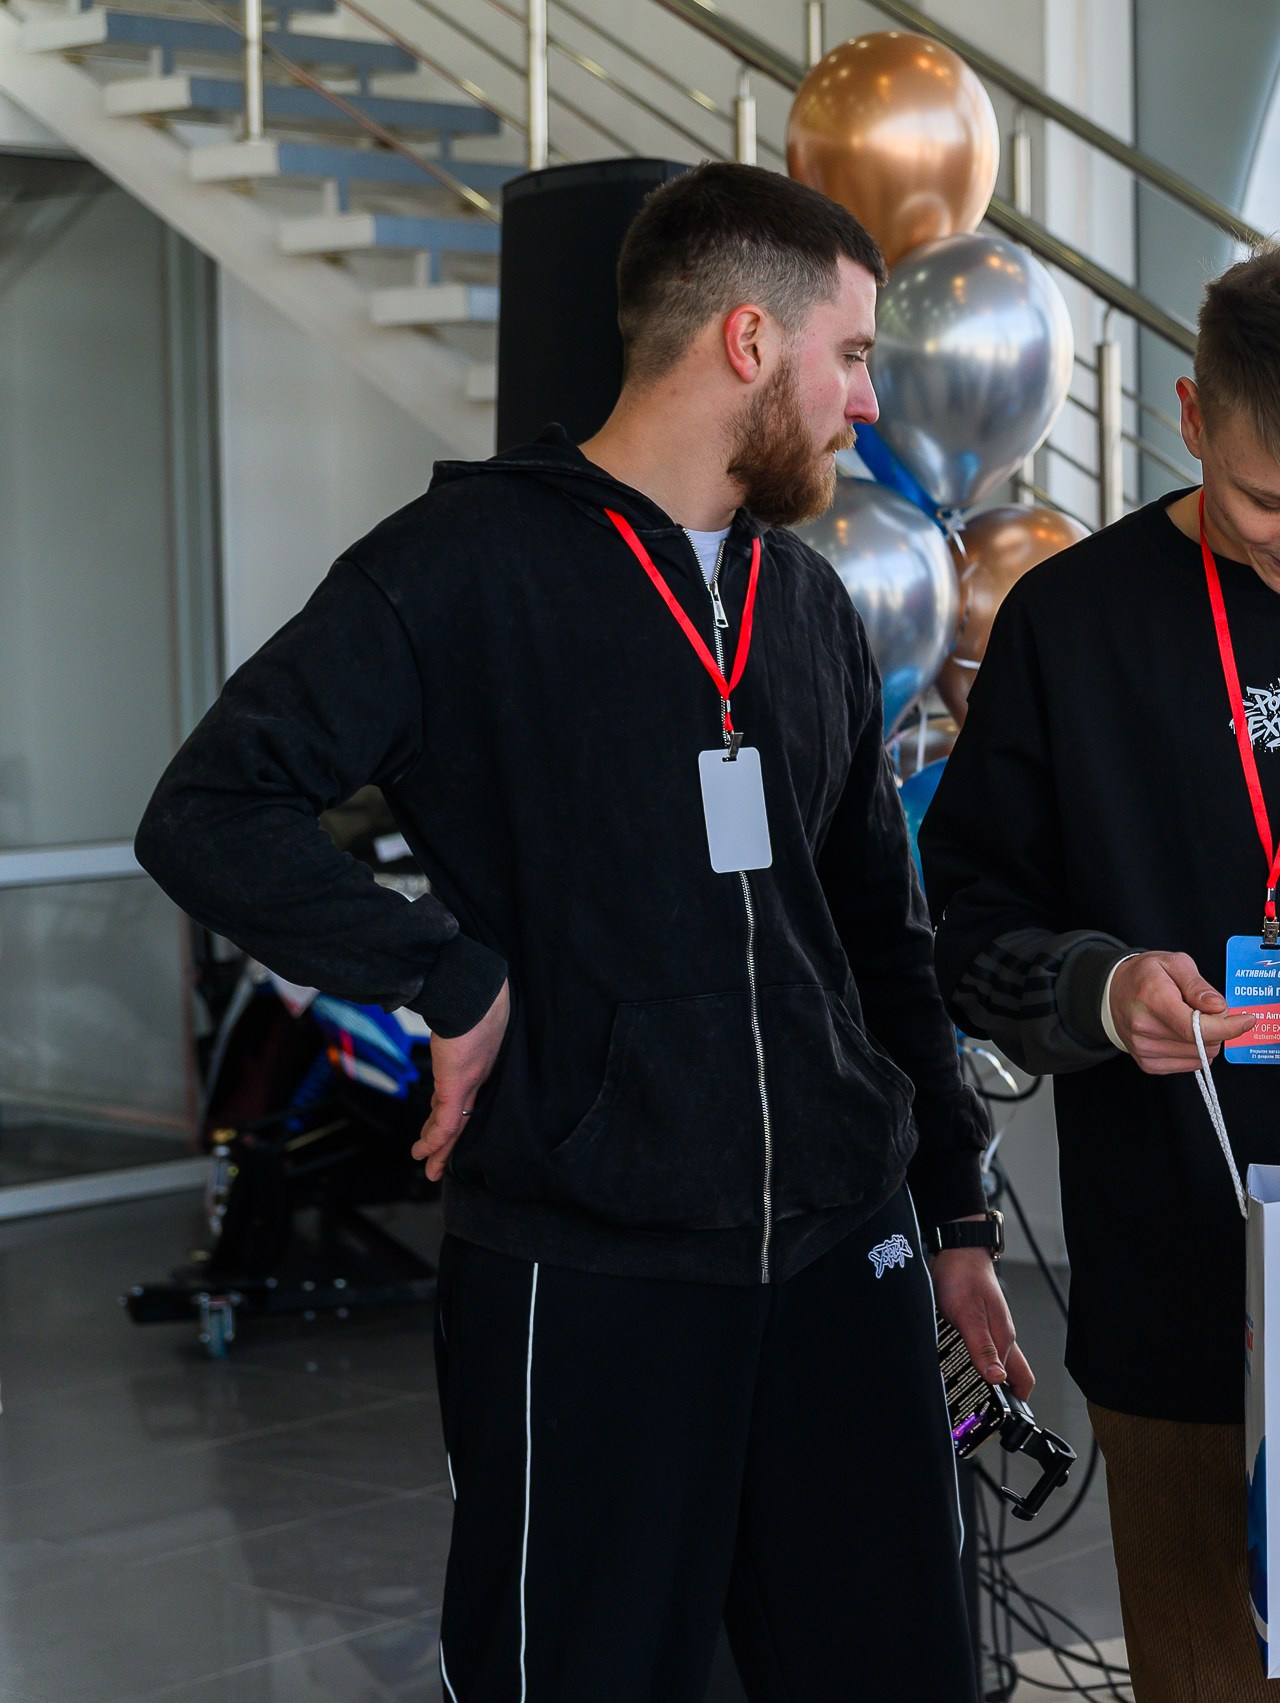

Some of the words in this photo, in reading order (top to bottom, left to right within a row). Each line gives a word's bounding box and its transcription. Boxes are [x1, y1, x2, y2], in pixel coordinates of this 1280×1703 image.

[1235, 969, 1276, 978] АКТИВНЫЙ
[1234, 985, 1274, 997] ОСОБЫЙ
[1261, 1023, 1271, 1032] OF
